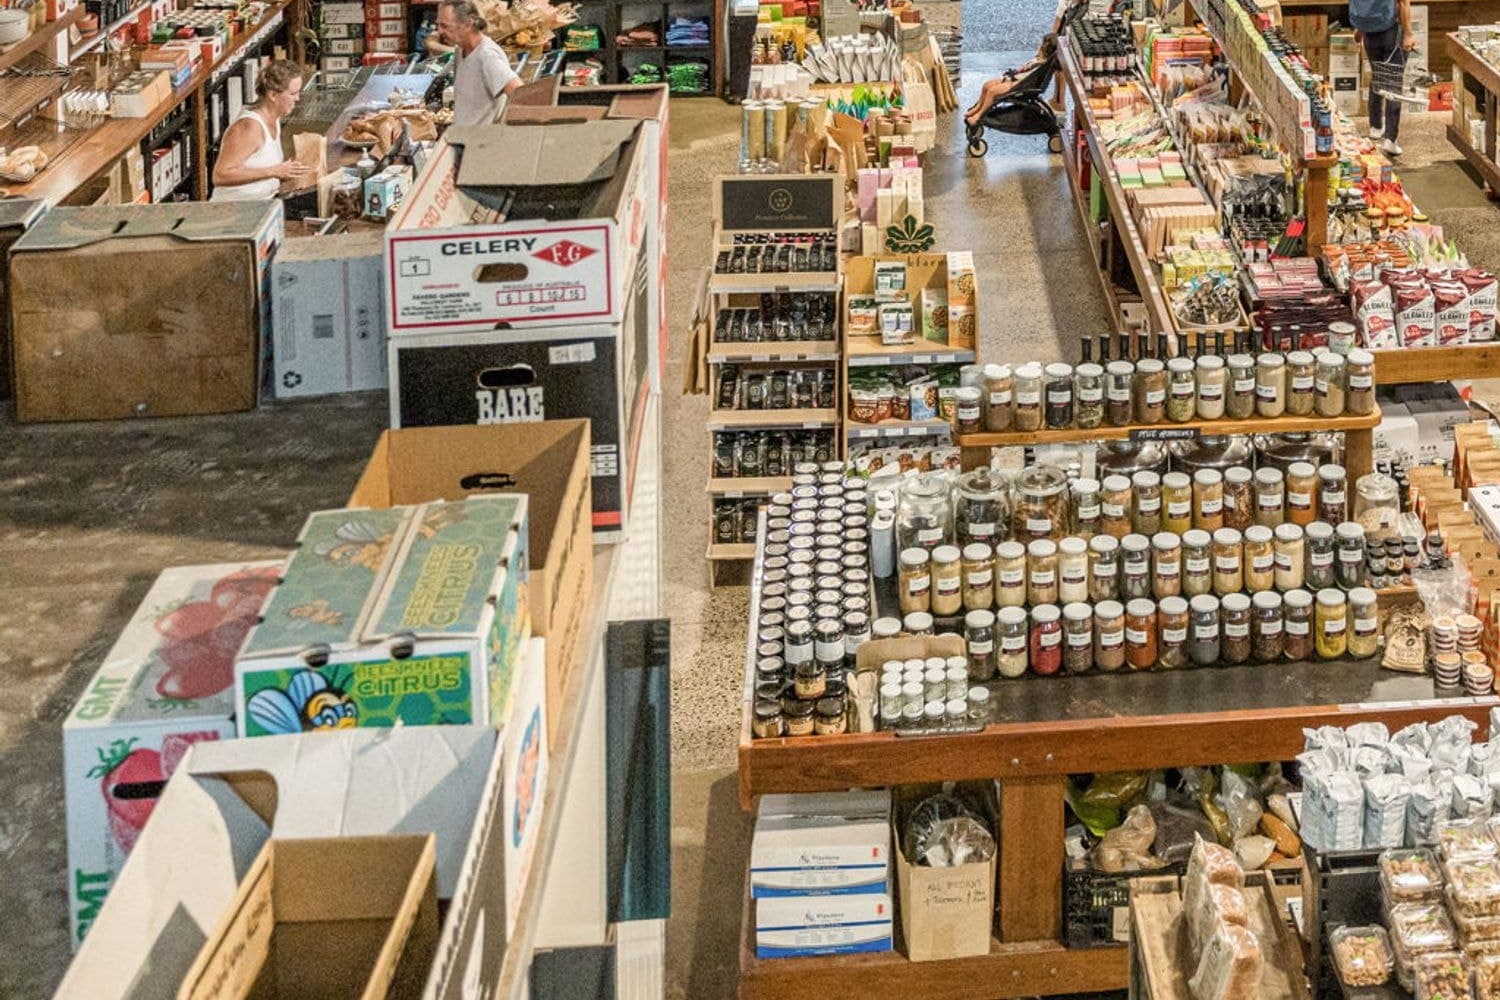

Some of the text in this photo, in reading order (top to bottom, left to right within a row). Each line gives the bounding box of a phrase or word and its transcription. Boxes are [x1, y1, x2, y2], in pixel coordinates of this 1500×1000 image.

[441, 237, 537, 256] CELERY
[529, 305, 555, 313] Count
[476, 386, 544, 425] BARE
[357, 674, 460, 695] CITRUS
[76, 677, 126, 720] GMT
